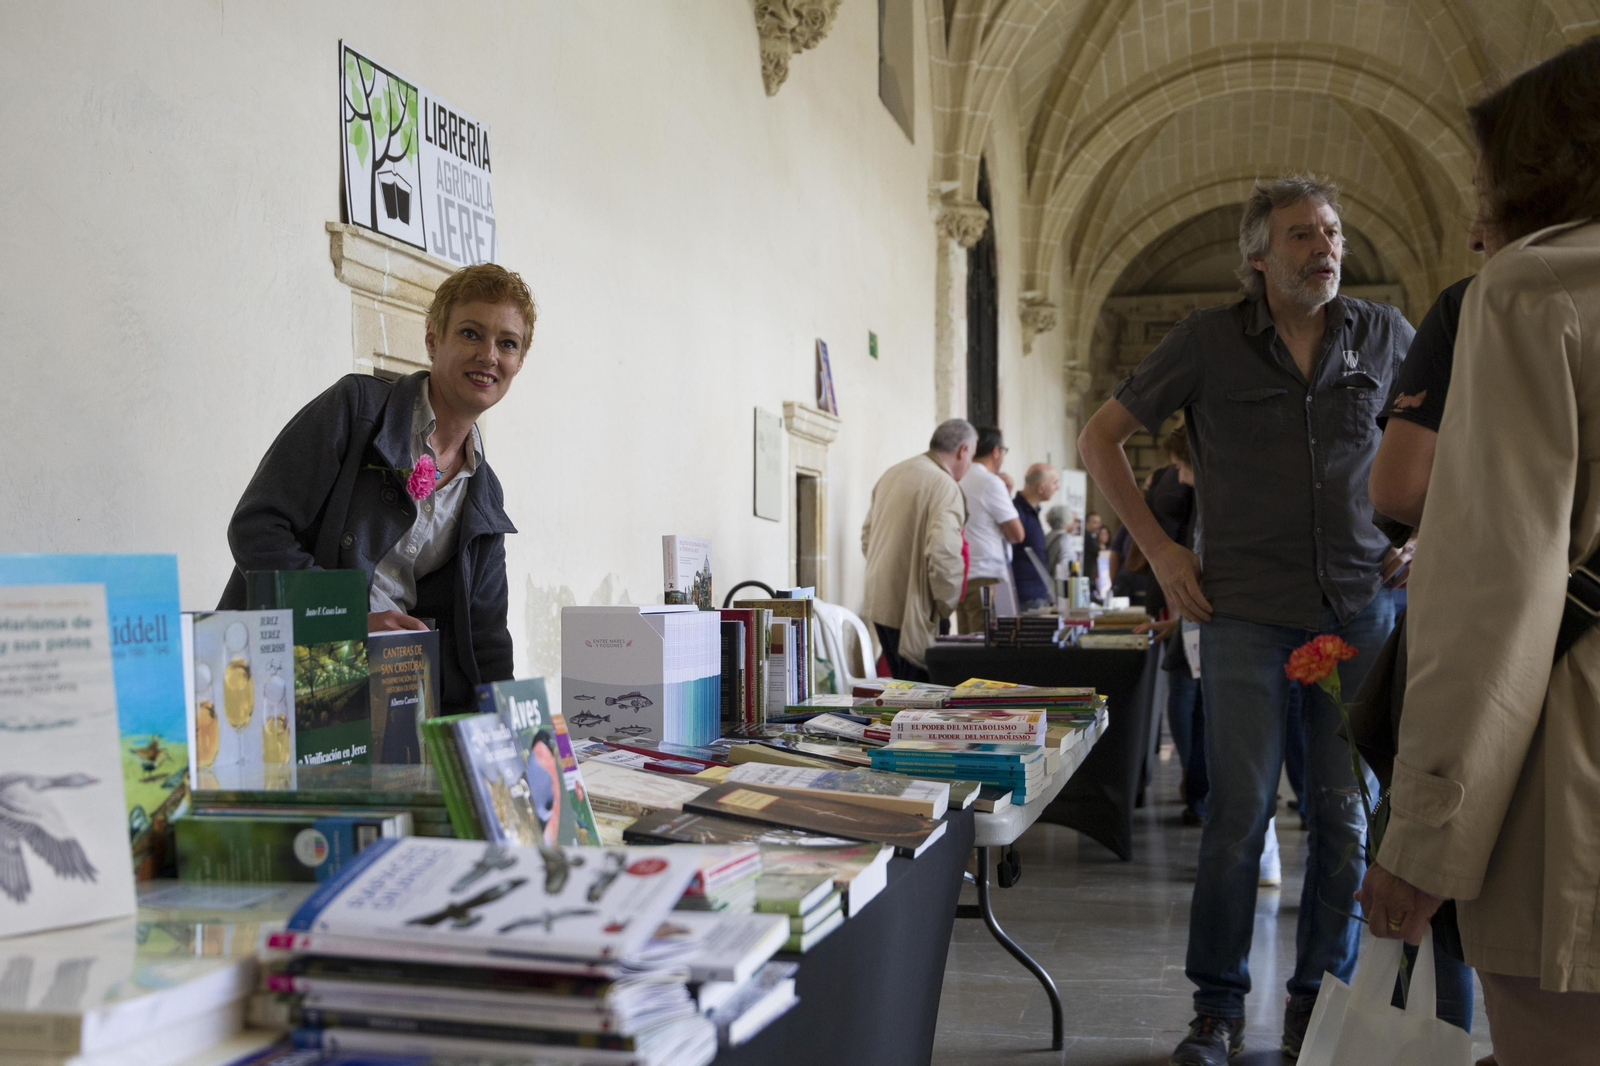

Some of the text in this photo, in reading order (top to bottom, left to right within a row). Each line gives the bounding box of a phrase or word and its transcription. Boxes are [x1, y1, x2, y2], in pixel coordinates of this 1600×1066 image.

[424, 96, 491, 173] LIBRERÍA
[436, 156, 494, 213] AGRÍCOLA
[71, 613, 92, 629] de
[260, 616, 279, 626] JEREZ
[13, 639, 40, 652] sus
[46, 636, 91, 653] patos
[382, 644, 423, 659] CANTERAS DE
[381, 659, 425, 675] SAN CRISTÓBAL
[508, 695, 542, 731] Aves
[304, 748, 342, 765] Vinificación
[342, 748, 351, 758] en
[351, 744, 367, 758] Jerez
